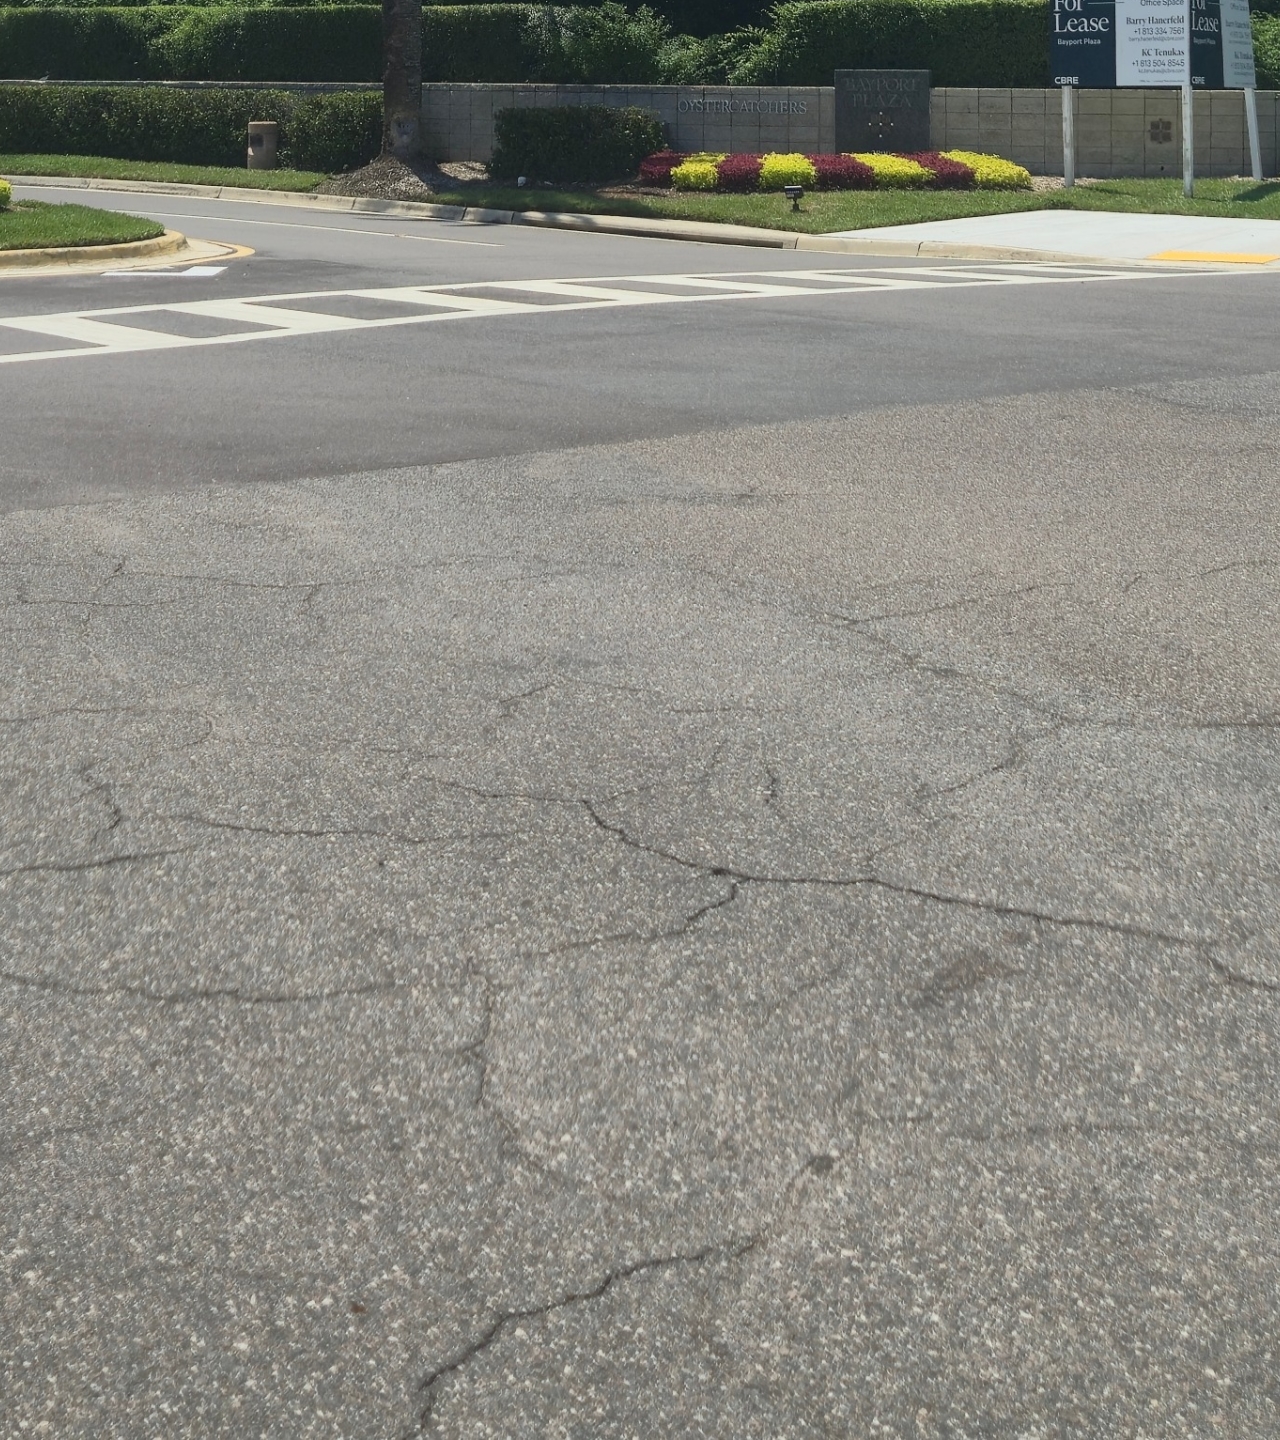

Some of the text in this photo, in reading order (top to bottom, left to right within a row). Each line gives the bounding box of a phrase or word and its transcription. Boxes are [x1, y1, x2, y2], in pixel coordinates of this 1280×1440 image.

[1053, 13, 1110, 33] Lease
[1126, 16, 1146, 27] Barry
[1191, 10, 1219, 32] Lease
[1142, 27, 1154, 35] 813
[1154, 27, 1167, 35] 334
[1057, 38, 1082, 46] Bayport
[1141, 48, 1152, 57] KC
[1140, 59, 1151, 67] 813
[1152, 59, 1166, 67] 504
[1167, 59, 1185, 67] 8545
[843, 77, 919, 92] BAYPORT
[1054, 76, 1079, 85] CBRE
[1191, 76, 1205, 84] CBRE
[852, 93, 912, 108] PLAZA
[677, 99, 807, 115] OYSTERCATCHERS
